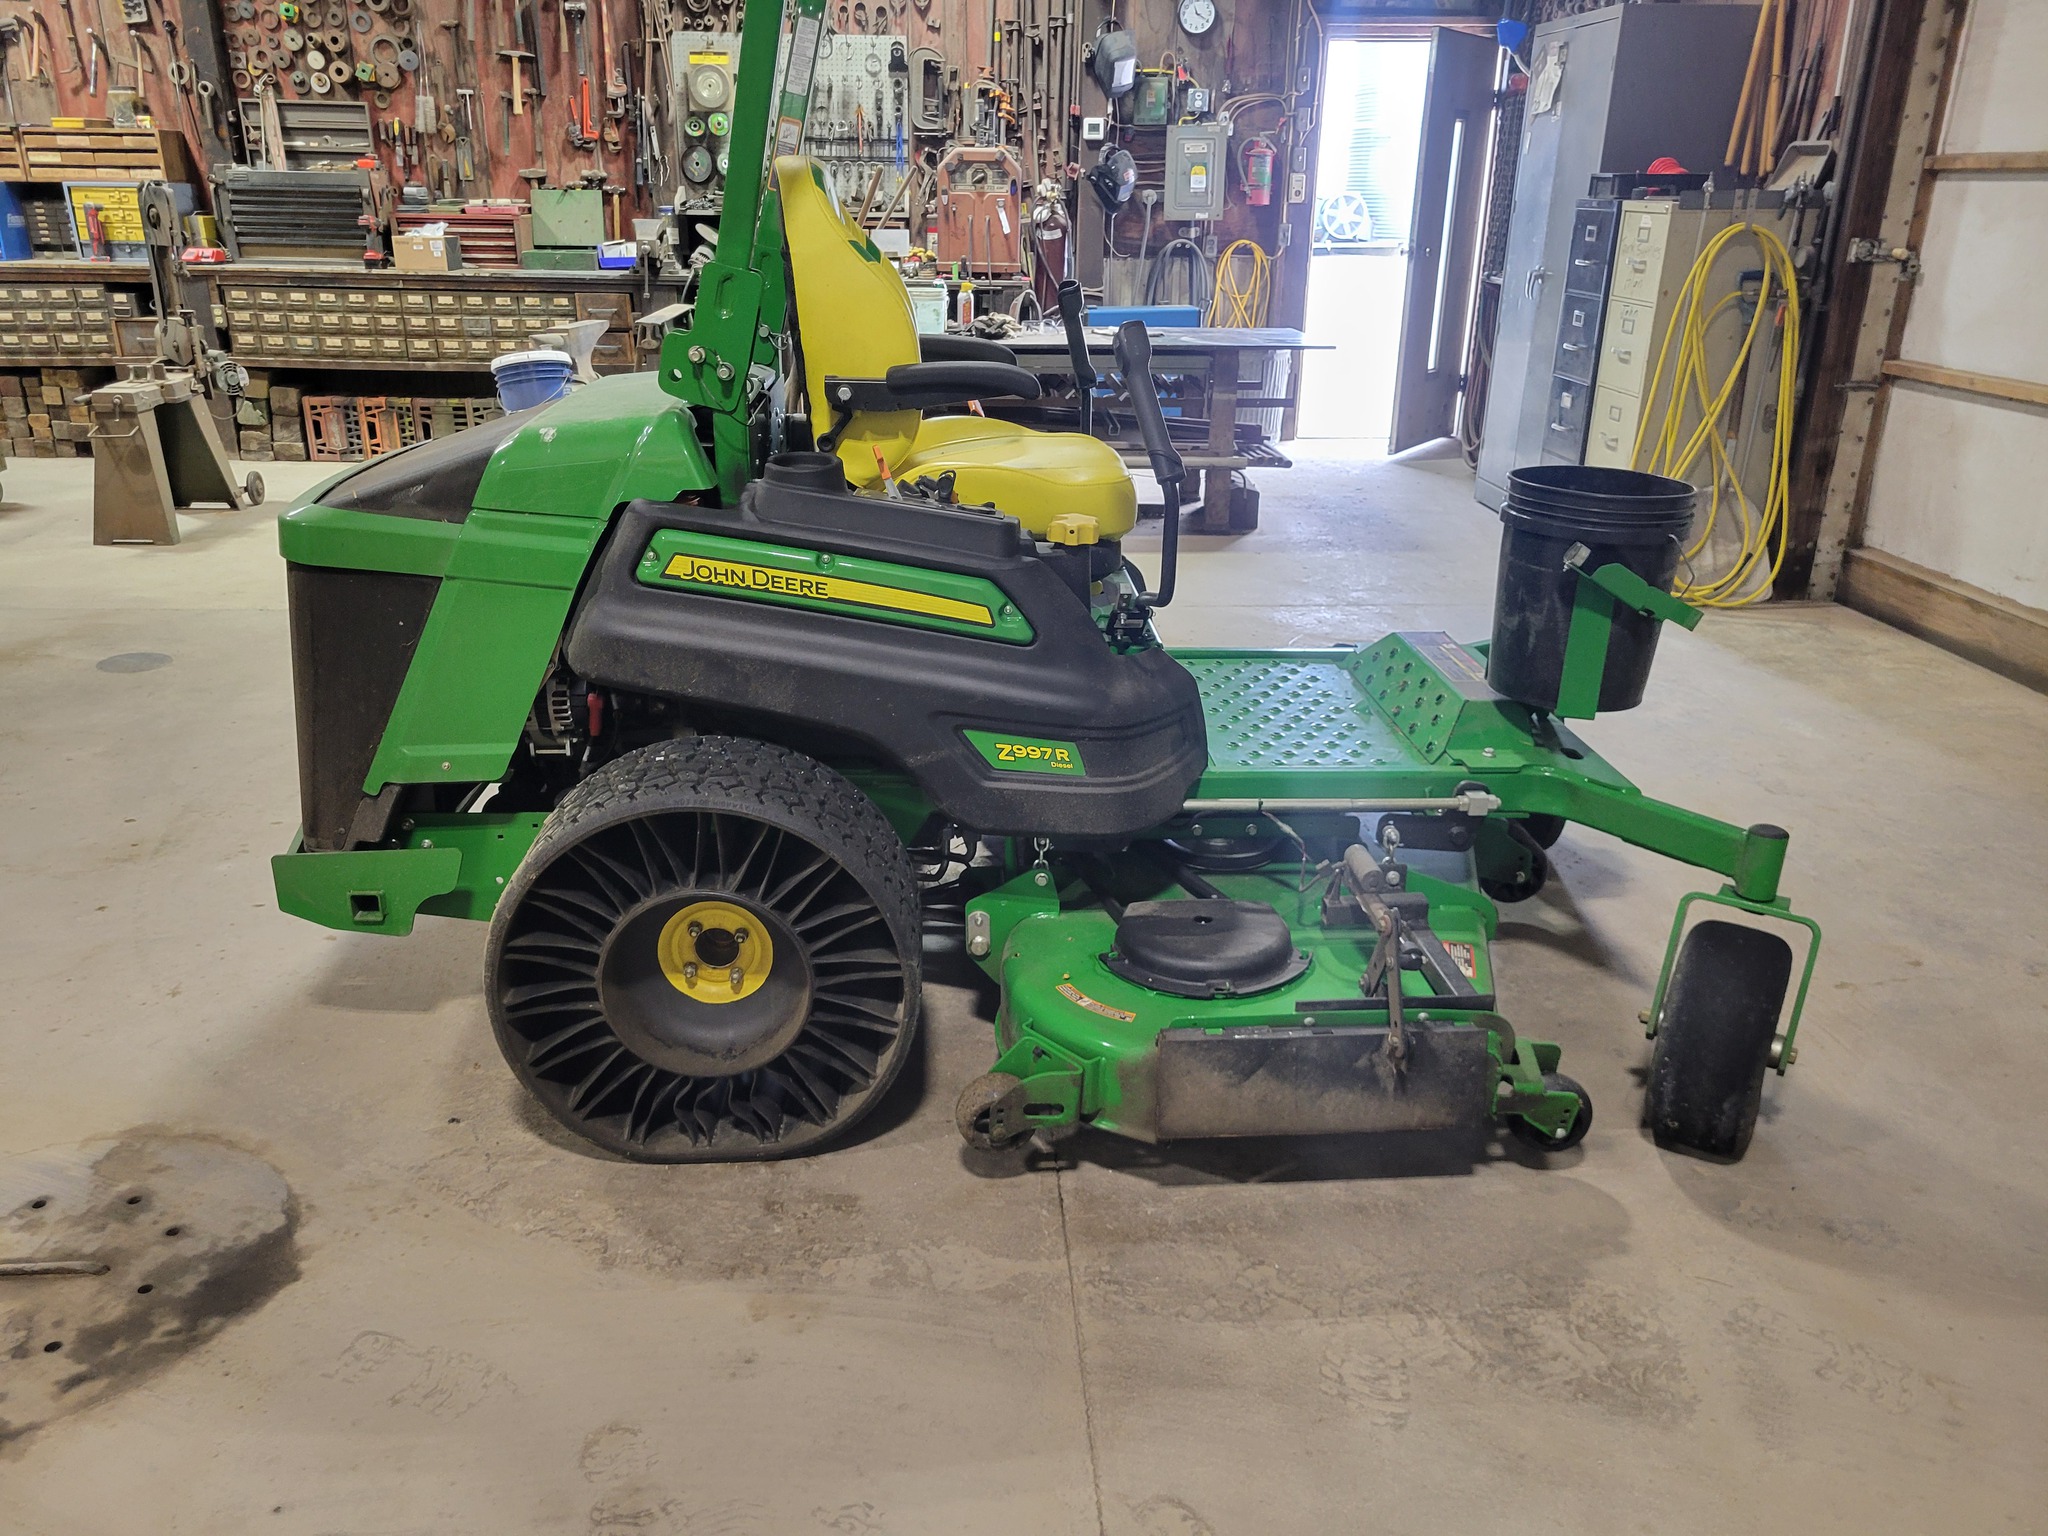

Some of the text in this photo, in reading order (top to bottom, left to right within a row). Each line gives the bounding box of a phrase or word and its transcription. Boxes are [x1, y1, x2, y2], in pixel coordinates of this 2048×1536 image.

[683, 560, 828, 596] JOHN DEERE
[995, 743, 1070, 762] Z997R
[1050, 761, 1074, 769] Diesel
